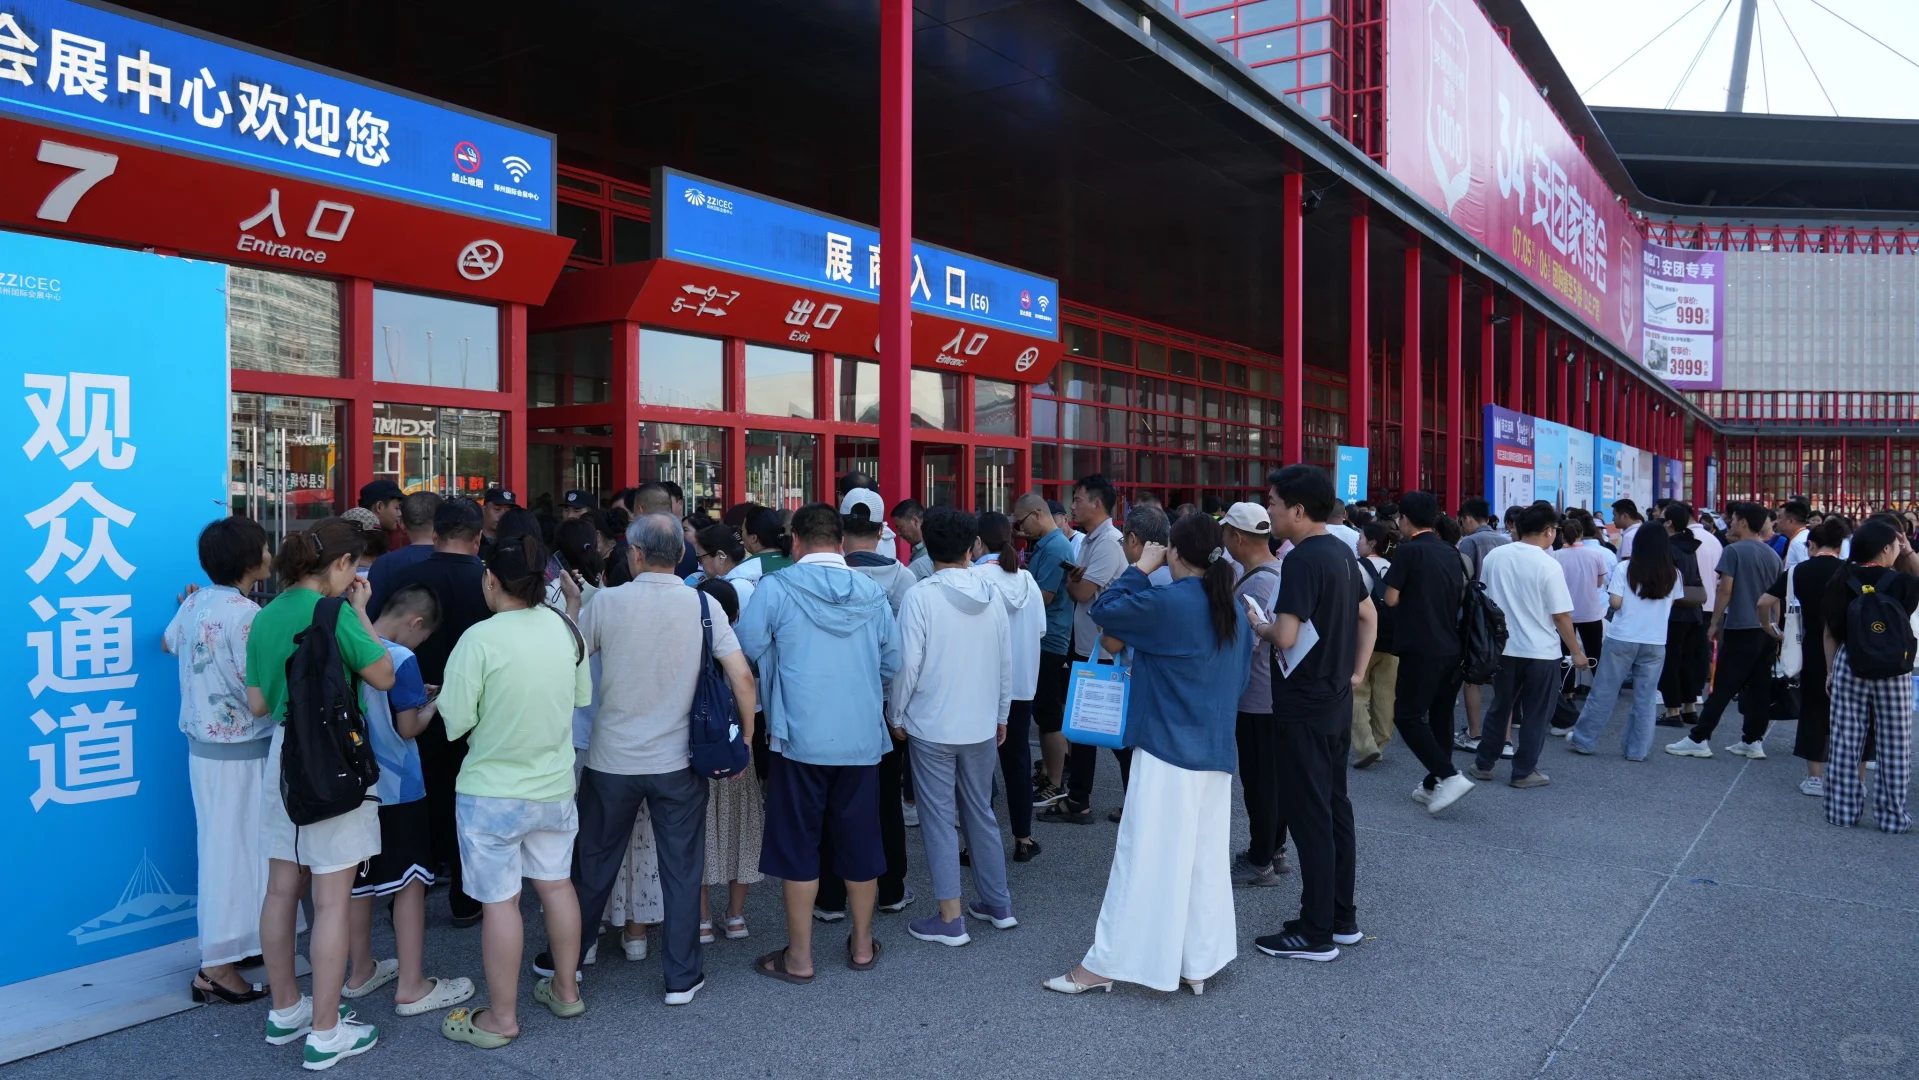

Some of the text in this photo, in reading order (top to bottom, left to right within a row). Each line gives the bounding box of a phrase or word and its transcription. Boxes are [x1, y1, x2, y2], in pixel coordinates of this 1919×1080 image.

[0, 12, 391, 168] 会展中心欢迎您
[36, 140, 120, 223] 7
[451, 172, 484, 188] 禁止吸烟
[239, 187, 355, 242] 入口
[706, 195, 733, 210] ZZICEC
[236, 234, 327, 264] Entrance
[1661, 259, 1716, 279] 安团专享
[784, 299, 843, 330] 出口
[1676, 306, 1703, 324] 999
[788, 329, 811, 344] Exit
[940, 328, 989, 356] 入口
[1670, 358, 1703, 376] 3999
[22, 371, 142, 814] 观众通道
